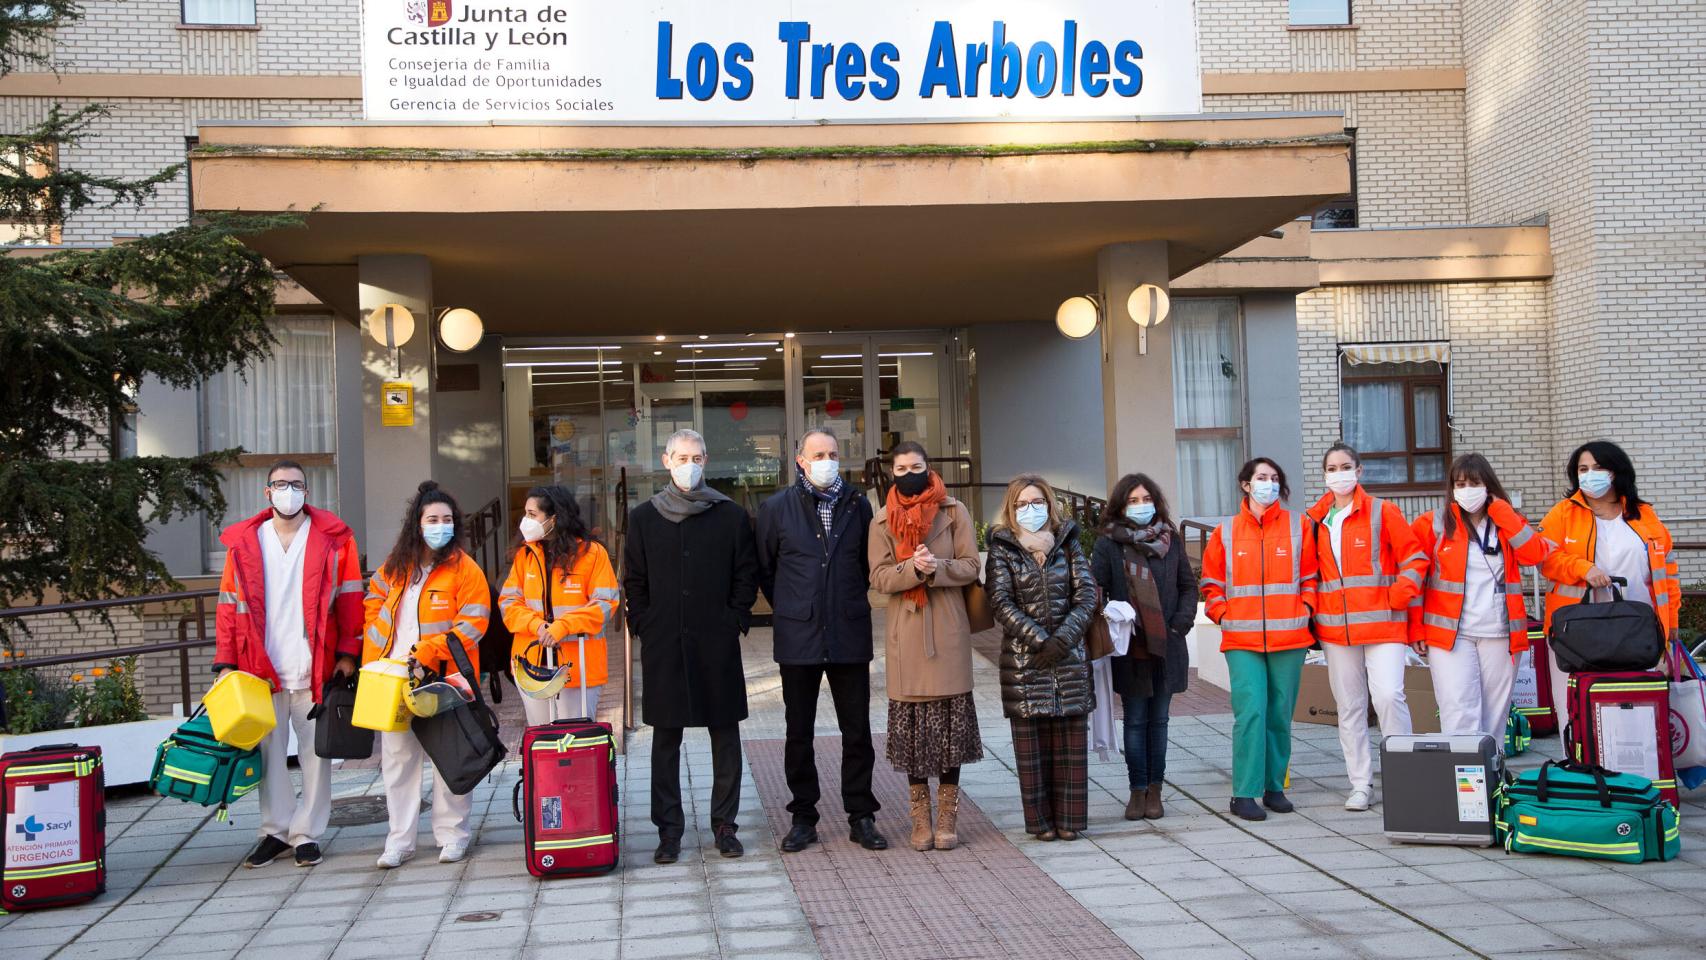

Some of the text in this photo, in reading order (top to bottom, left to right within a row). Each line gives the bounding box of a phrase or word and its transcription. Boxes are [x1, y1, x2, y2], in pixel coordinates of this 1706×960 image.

[457, 4, 567, 23] Junta de
[387, 26, 567, 51] Castilla y León
[473, 58, 491, 71] de
[497, 58, 550, 71] Familia
[656, 19, 1144, 102] Los Tres Arboles
[389, 75, 602, 90] e Igualdad de Oportunidades
[389, 98, 614, 111] Gerencia de Servicios Sociales
[1515, 677, 1532, 686] acyl
[46, 820, 72, 831] Sacyl
[7, 839, 79, 852] ATENCIÓN PRIMARIA
[12, 848, 74, 862] URGENCIAS
